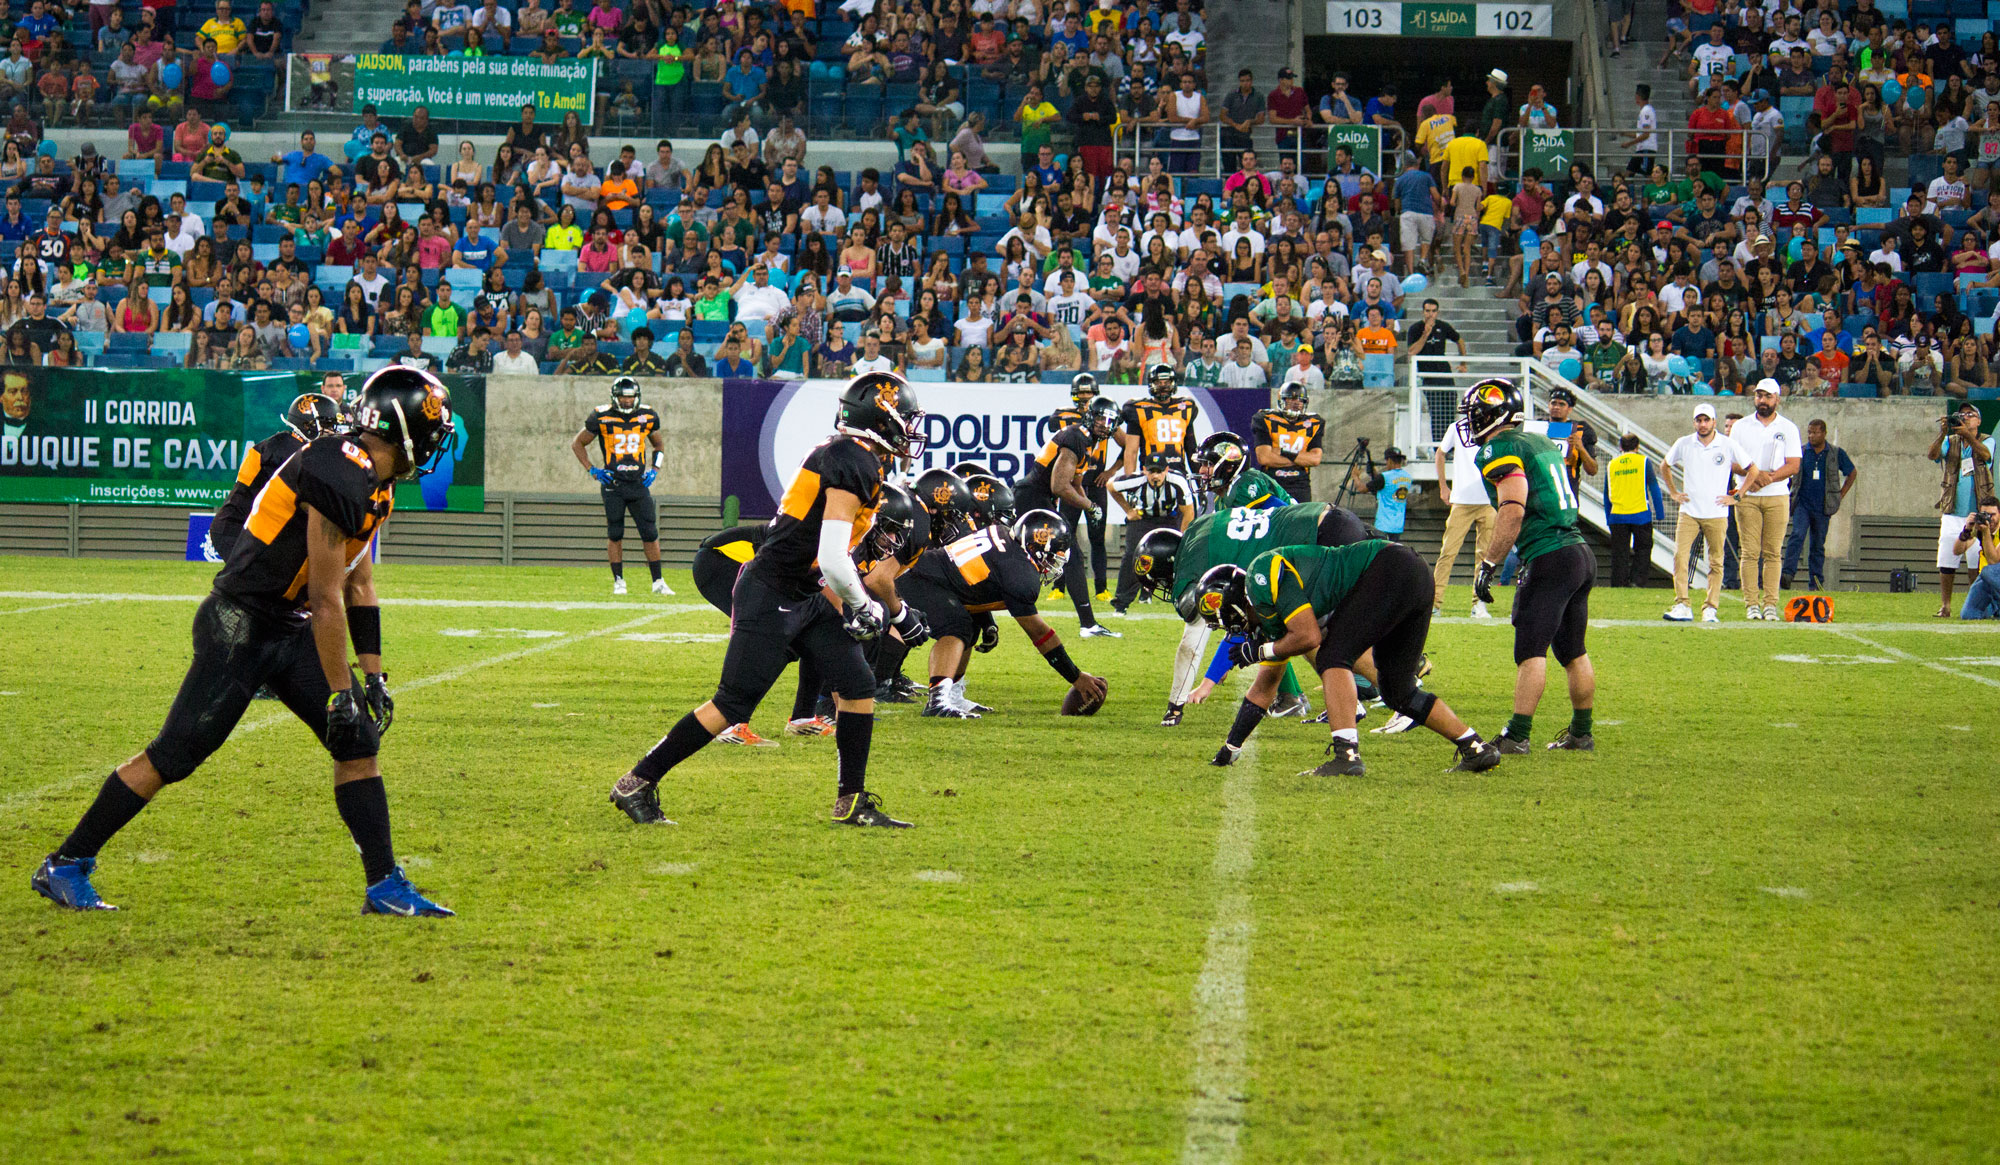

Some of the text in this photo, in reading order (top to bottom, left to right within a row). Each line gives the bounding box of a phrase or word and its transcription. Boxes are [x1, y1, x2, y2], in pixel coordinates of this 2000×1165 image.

[1343, 9, 1382, 28] 103
[1430, 11, 1467, 24] SAÍDA
[1493, 10, 1533, 30] 102
[356, 53, 587, 83] JADSON, parabéns pela sua determinação
[357, 86, 586, 110] e superação. Você é um vencedor! Te Amo!!!
[1337, 132, 1369, 144] SAÍDA
[1532, 135, 1565, 147] SAÍDA
[1985, 142, 1998, 155] 87
[41, 240, 64, 258] 30
[85, 400, 196, 425] II CORRIDA
[361, 407, 380, 430] 83
[1156, 419, 1182, 442] 85
[1, 435, 100, 470] DUQUE
[113, 437, 151, 467] DE
[614, 433, 640, 454] 28
[91, 484, 170, 499] inscrições:
[1793, 597, 1830, 623] 20
